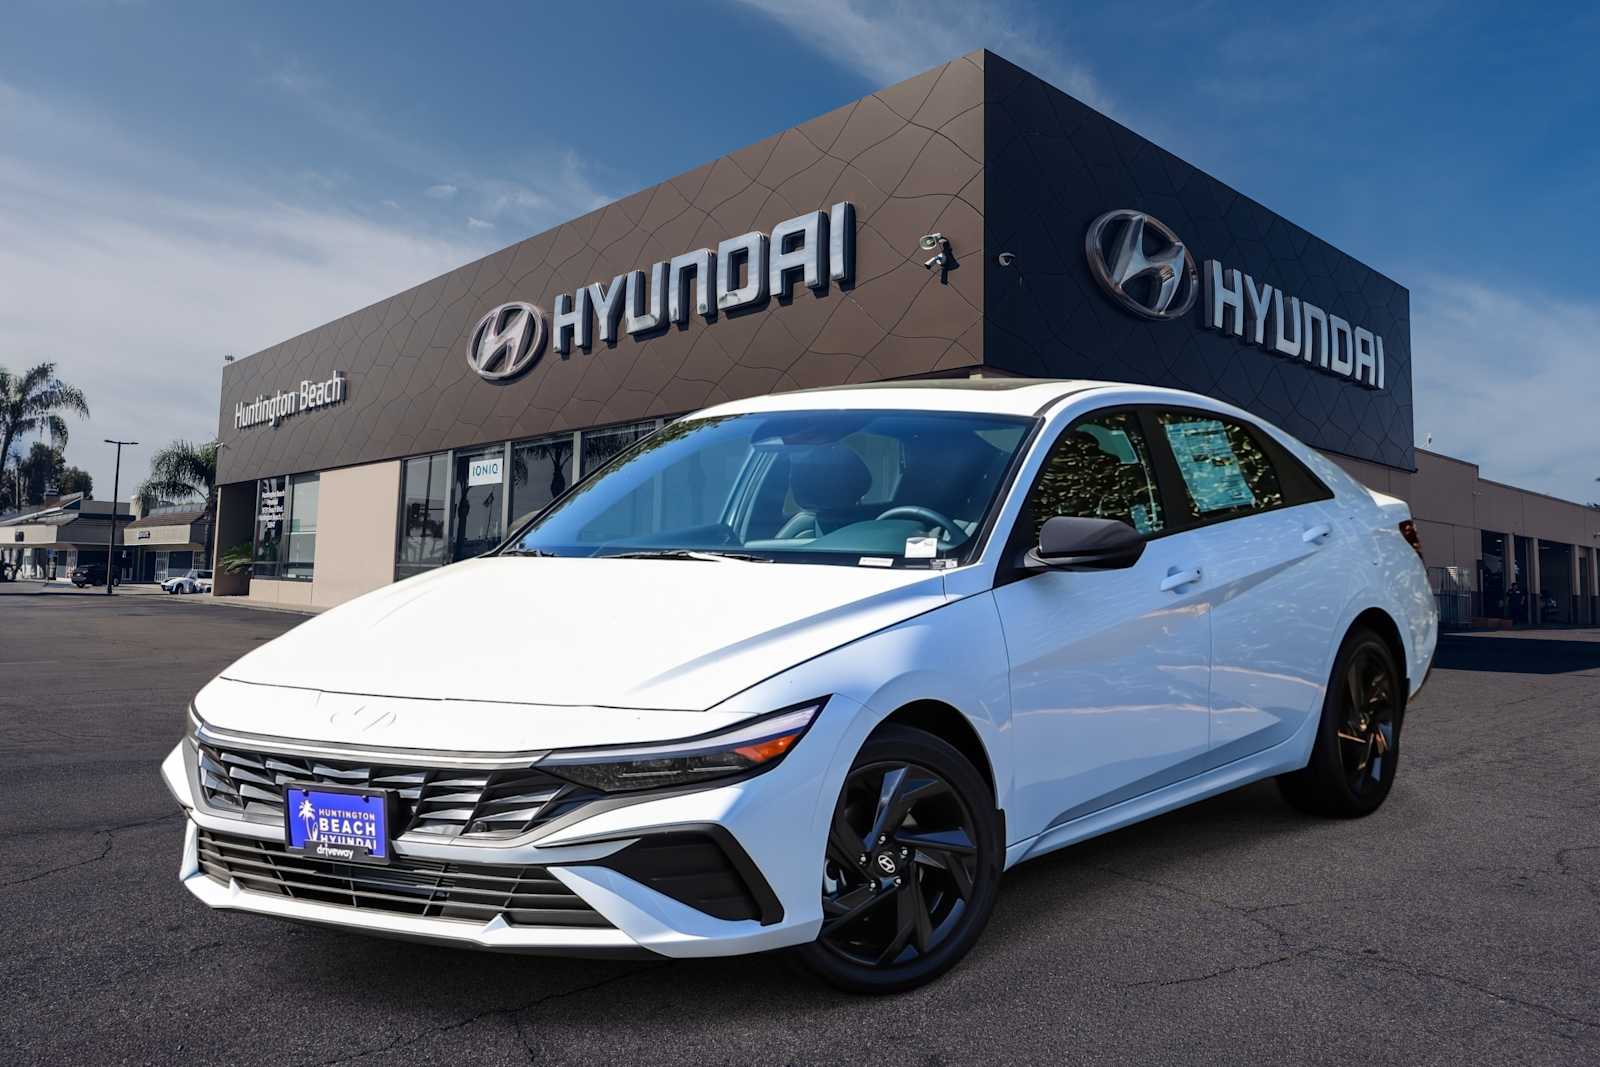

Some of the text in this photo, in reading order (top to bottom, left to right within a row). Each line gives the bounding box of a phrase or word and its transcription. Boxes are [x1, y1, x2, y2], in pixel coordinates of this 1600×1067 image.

[552, 201, 855, 354] HYUNDAI
[1206, 259, 1384, 390] HYUNDAI
[234, 370, 344, 429] Huntington Beach
[472, 463, 499, 477] IONIQ
[319, 808, 375, 820] HUNTINGTON
[319, 818, 376, 836] BEACH
[320, 834, 377, 850] HYUNDAI
[316, 843, 354, 860] driveway
